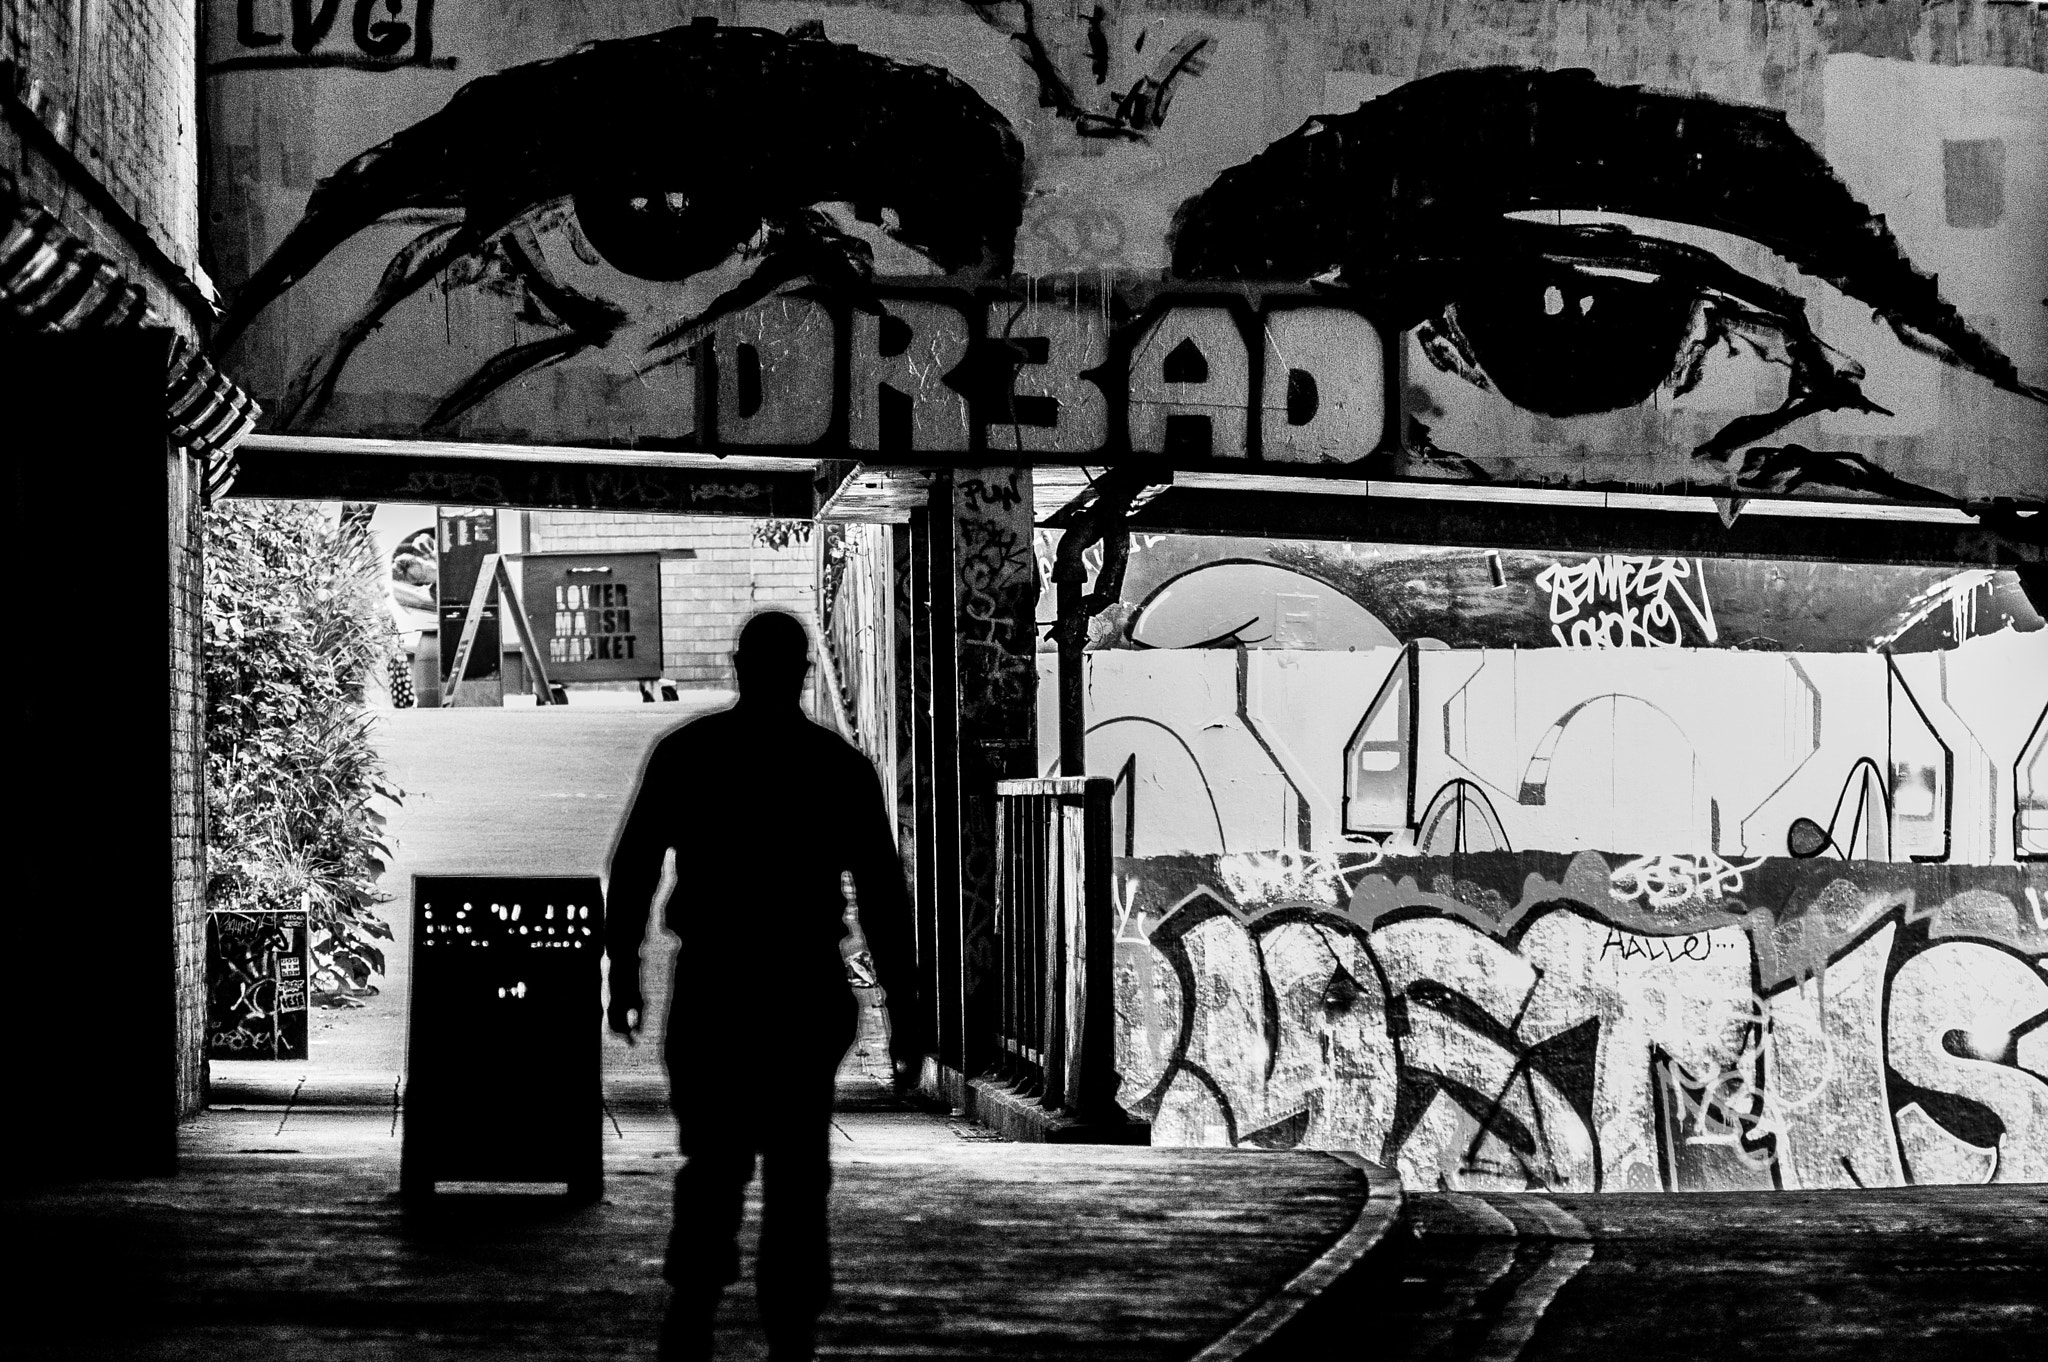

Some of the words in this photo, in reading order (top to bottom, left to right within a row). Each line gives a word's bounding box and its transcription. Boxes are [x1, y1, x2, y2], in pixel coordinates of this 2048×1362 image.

[708, 297, 1387, 466] DR3AD
[556, 584, 628, 610] LOWER
[550, 636, 637, 663] MARKET
